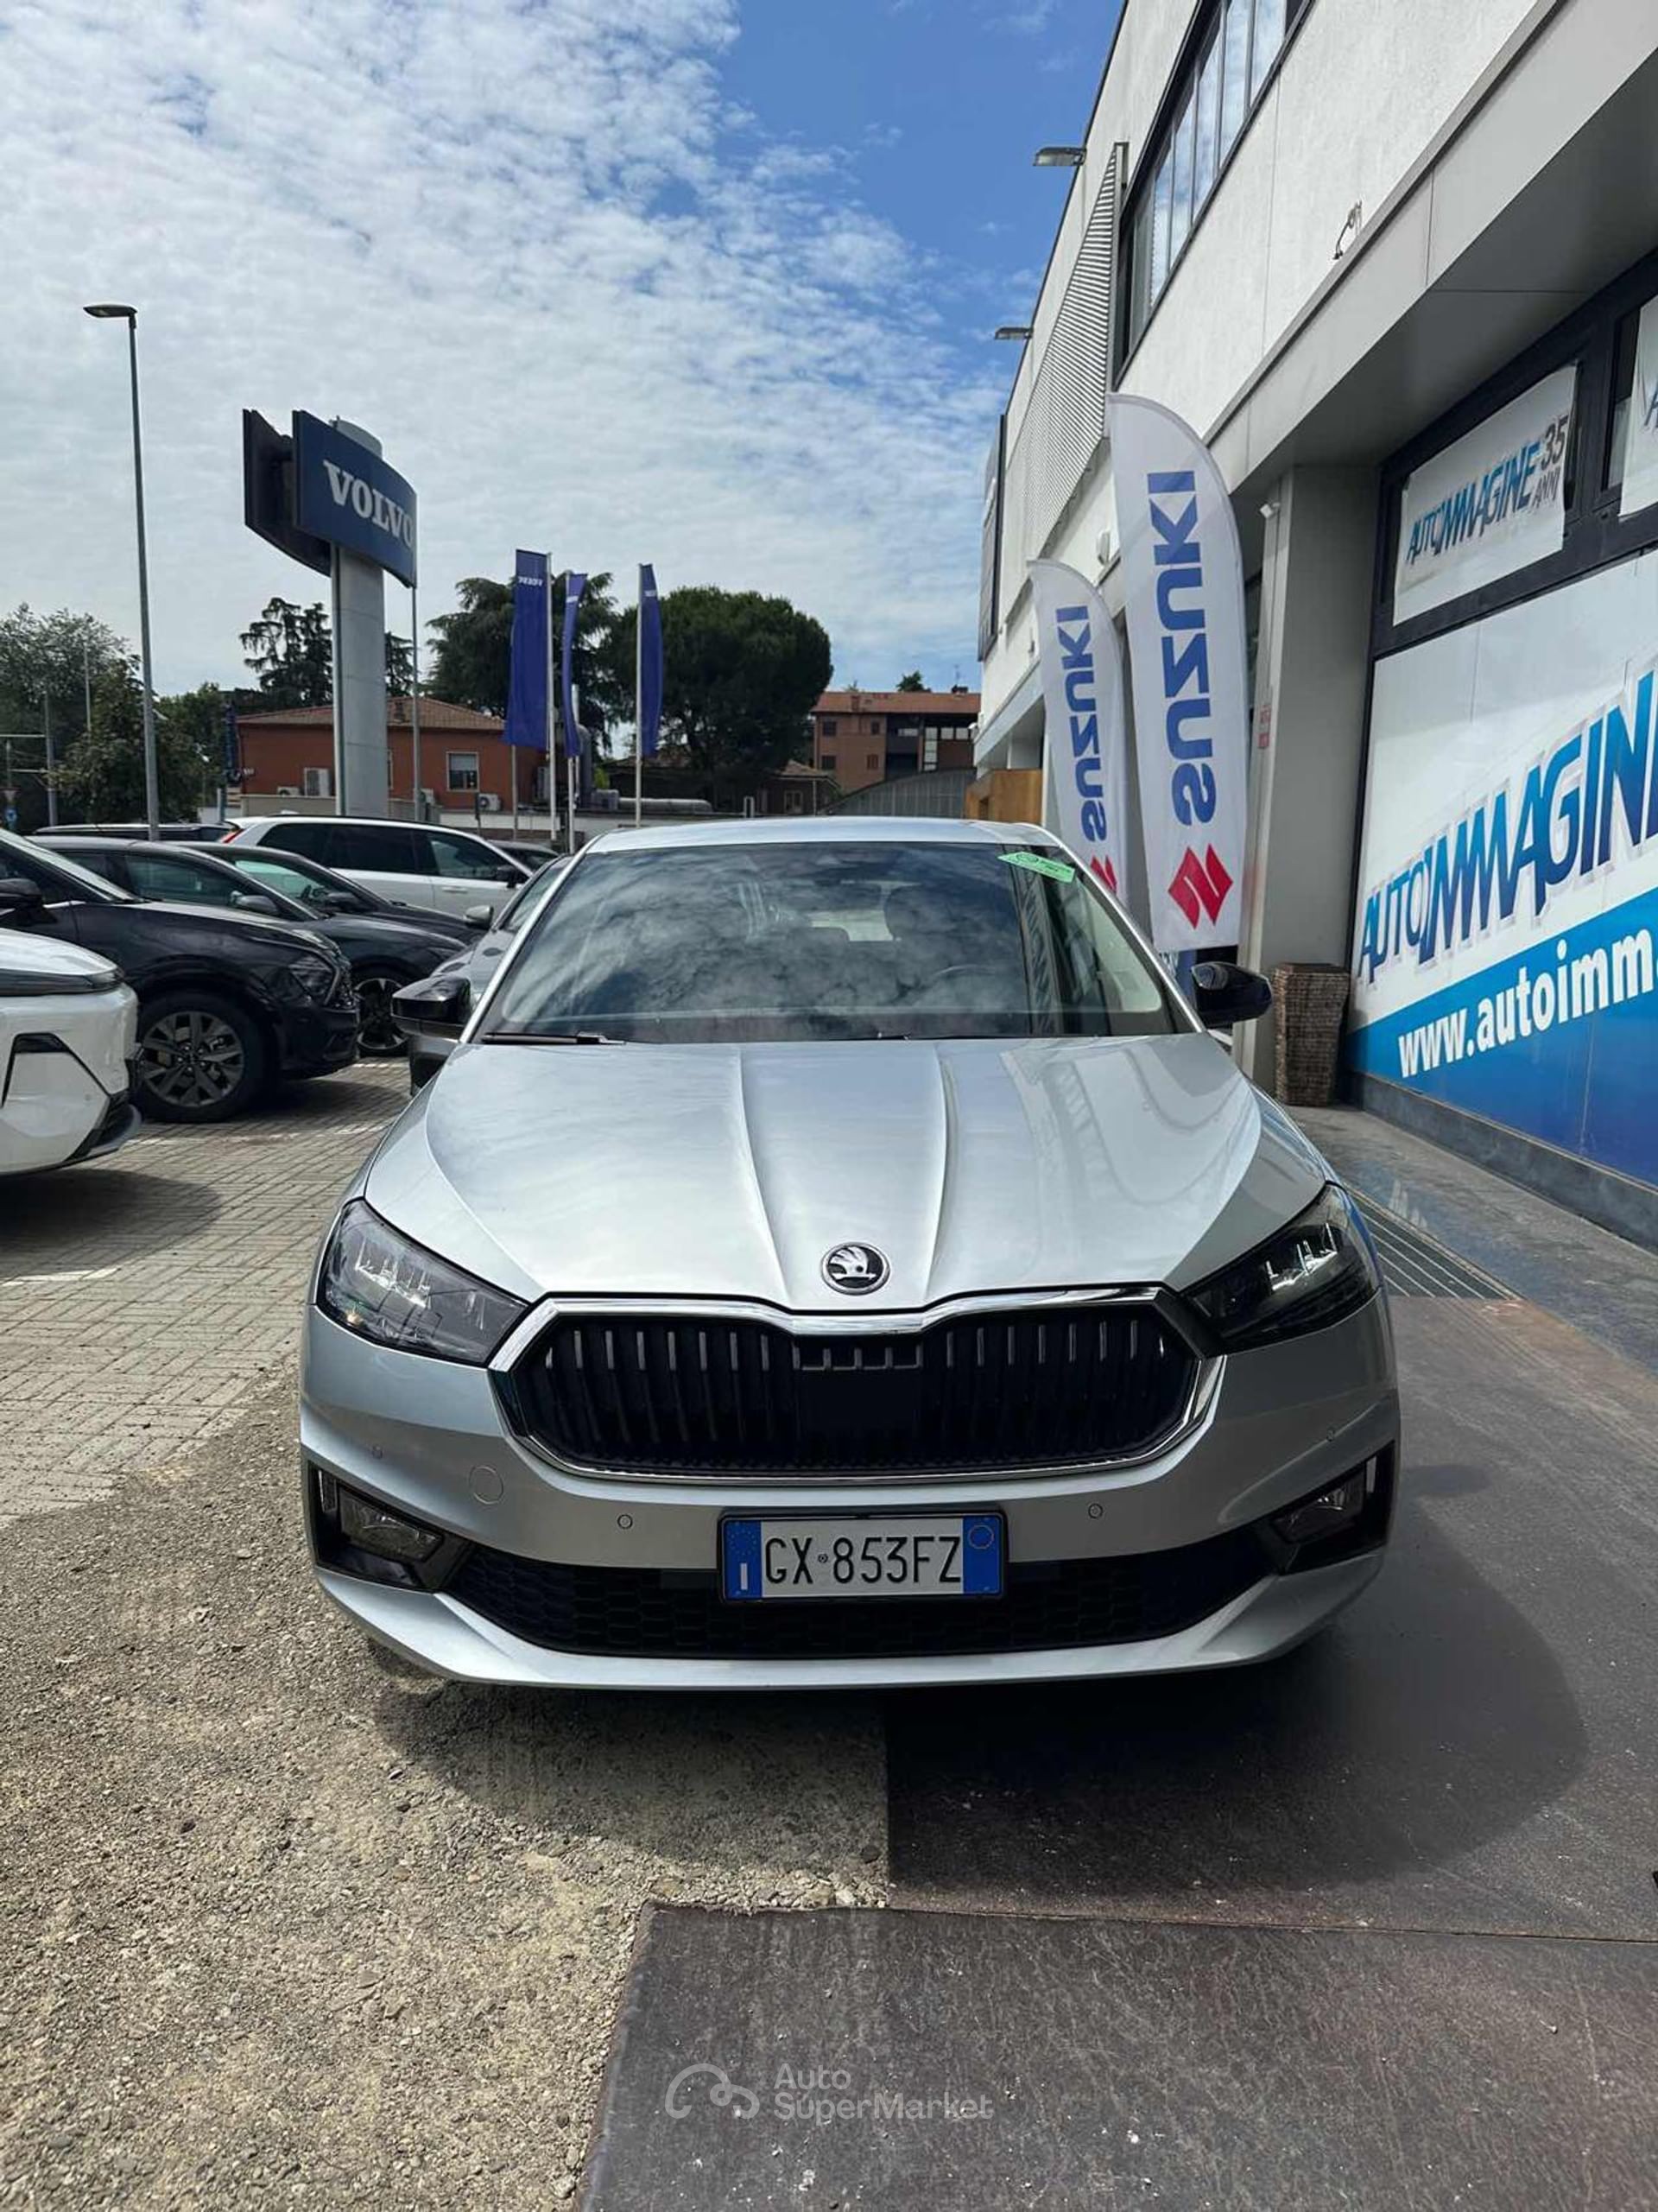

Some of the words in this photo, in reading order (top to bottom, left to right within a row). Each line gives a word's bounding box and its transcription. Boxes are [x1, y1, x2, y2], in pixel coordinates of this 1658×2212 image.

[1541, 415, 1569, 472] 35
[323, 459, 414, 549] VOLVO
[1398, 928, 1658, 1079] www.autoimm
